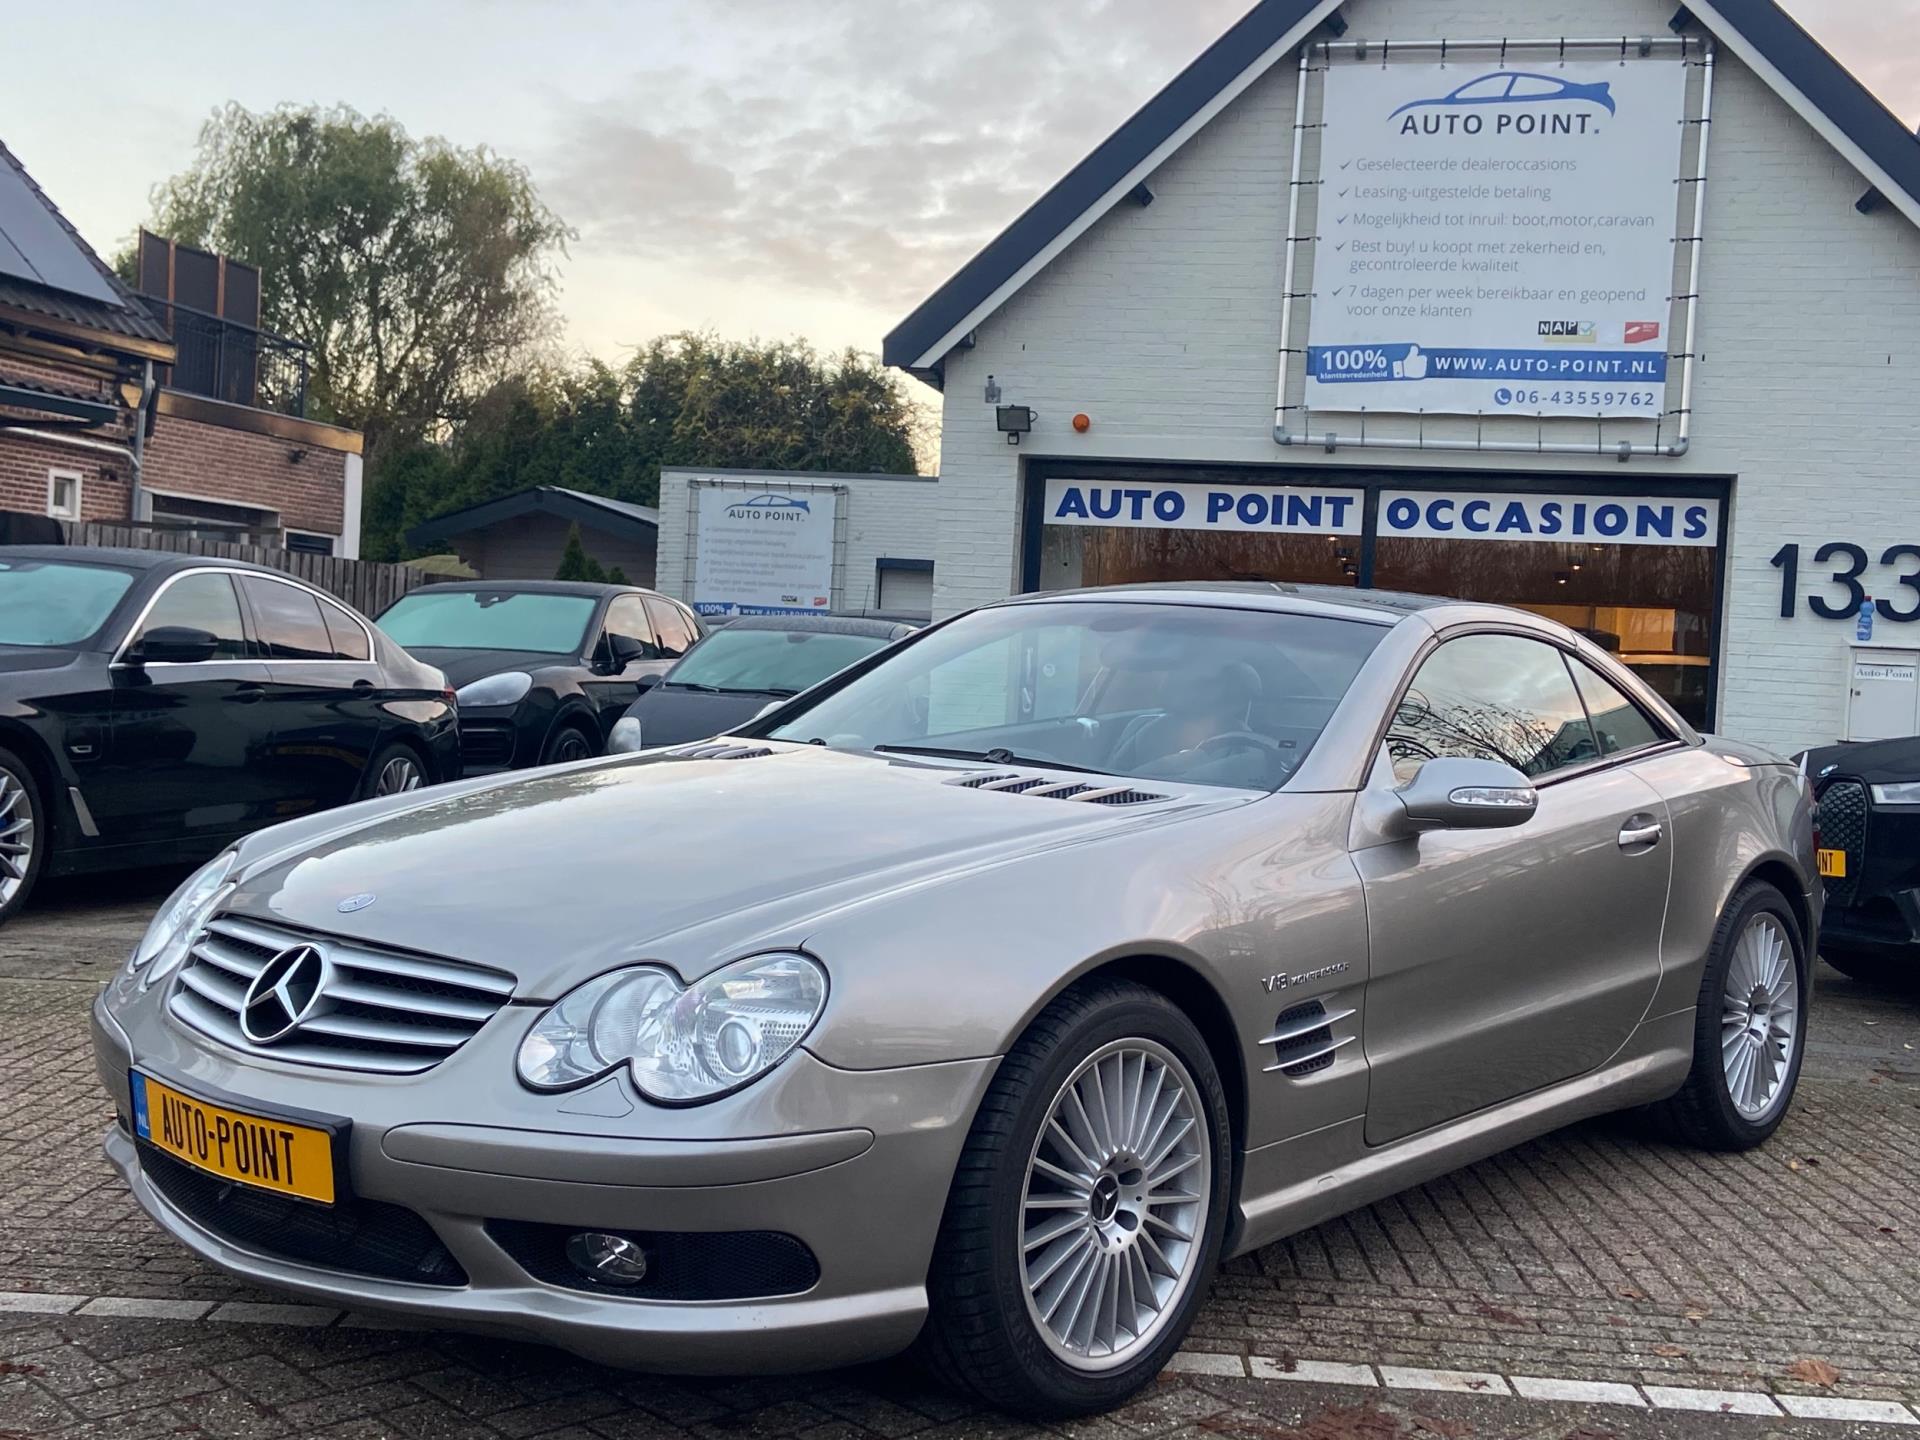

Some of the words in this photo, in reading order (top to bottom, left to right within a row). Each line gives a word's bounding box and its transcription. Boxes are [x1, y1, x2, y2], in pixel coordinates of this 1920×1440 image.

[1400, 114, 1482, 135] AUTO
[1356, 157, 1457, 171] Geselecteerde
[1461, 157, 1577, 171] dealeroccasions
[1354, 185, 1490, 201] Leasing-uitgestelde
[1494, 185, 1551, 202] betaling
[1353, 212, 1441, 229] Mogelijkheid
[1445, 214, 1464, 226] tot
[1512, 213, 1655, 228] boot,motor,caravan
[1351, 239, 1381, 253] Best
[1386, 240, 1415, 256] buy!
[1419, 243, 1428, 253] u
[1433, 240, 1472, 256] koopt
[1477, 242, 1505, 254] met
[1509, 241, 1580, 254] zekerheid
[1584, 243, 1606, 256] en,
[1349, 258, 1457, 274] gecontroleerde
[1462, 258, 1519, 272] kwaliteit
[1349, 285, 1358, 297] 7
[1361, 284, 1404, 301] dagen
[1408, 287, 1432, 301] per
[1436, 286, 1473, 299] week
[1477, 286, 1553, 300] bereikbaar
[1558, 289, 1576, 300] en
[1580, 288, 1646, 304] geopend
[1346, 305, 1378, 316] voor
[1382, 306, 1416, 317] onze
[1420, 304, 1472, 317] klanten
[1539, 321, 1577, 334] NAP
[1321, 349, 1387, 370] 100%
[1435, 356, 1657, 374] WWW.AUTO-POINT.NL
[1515, 390, 1654, 405] 06-43559762
[729, 510, 760, 520] AUTO
[1055, 486, 1185, 522] AUTO
[1206, 491, 1354, 528] POINT
[1386, 497, 1708, 539] OCCASIONS
[1769, 541, 1920, 622] 133
[699, 604, 725, 614] 100%
[1856, 668, 1913, 679] Auto-Point
[1261, 972, 1288, 994] V8
[162, 1093, 294, 1185] AUTO-POINT
